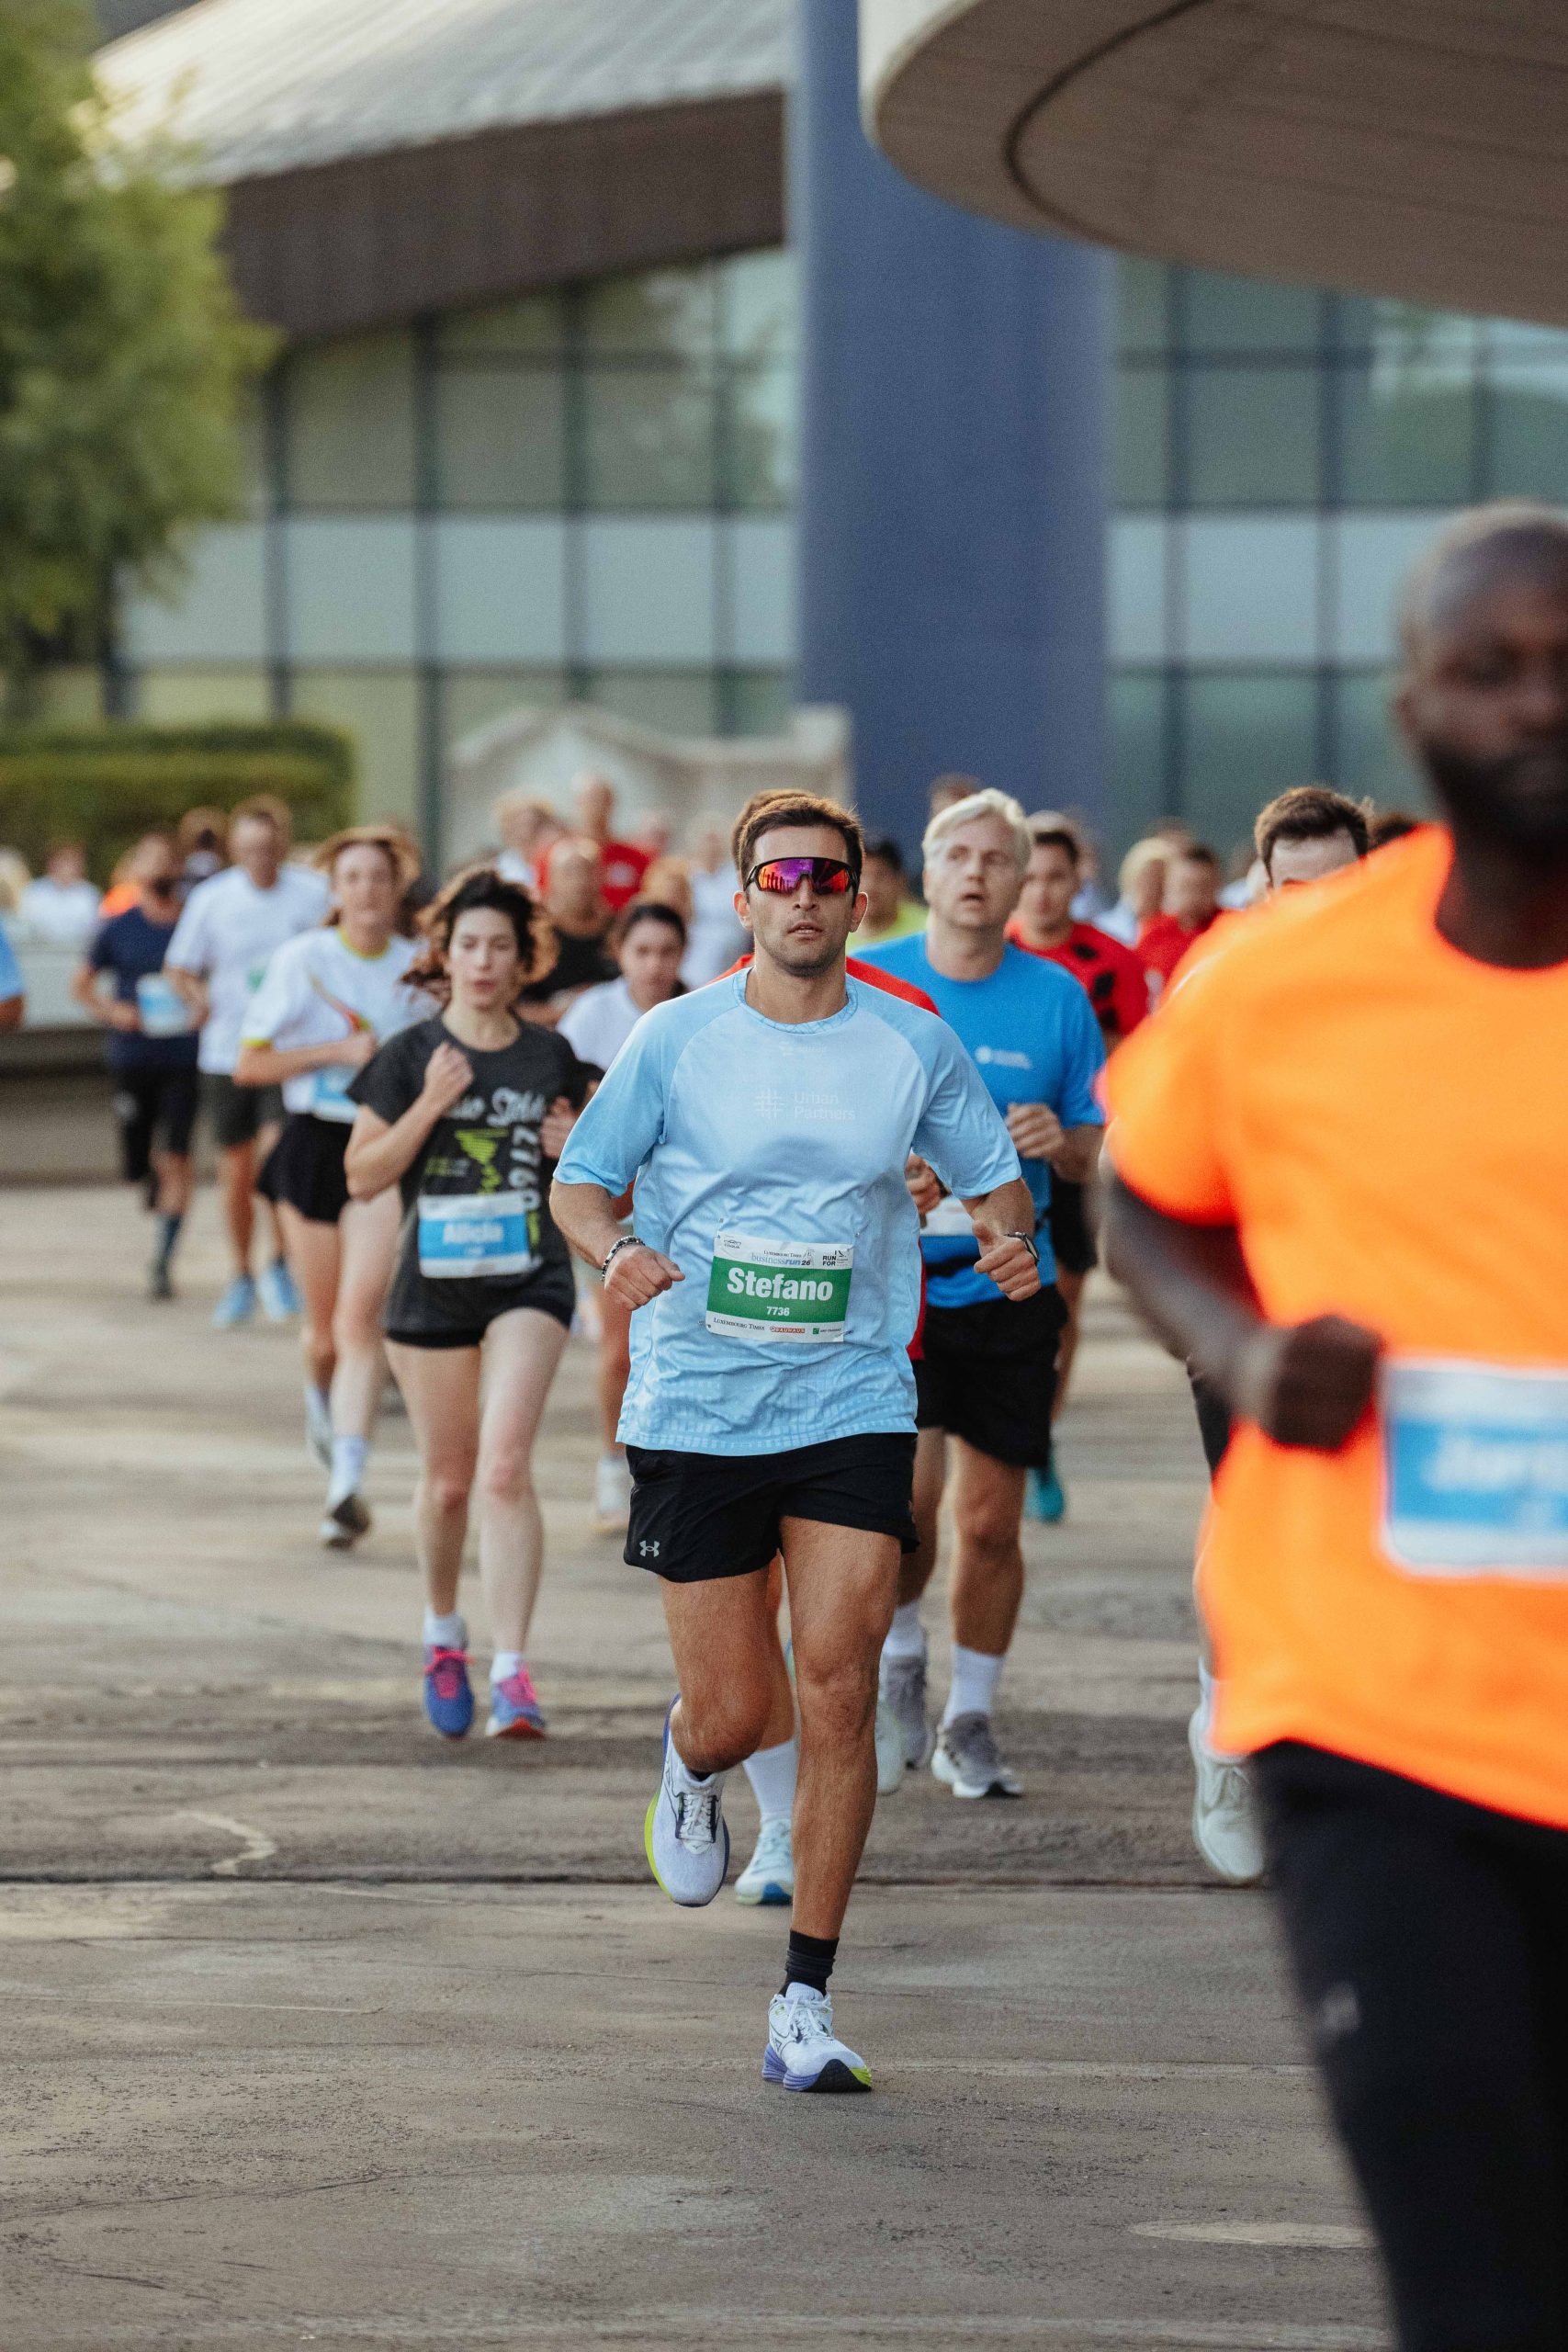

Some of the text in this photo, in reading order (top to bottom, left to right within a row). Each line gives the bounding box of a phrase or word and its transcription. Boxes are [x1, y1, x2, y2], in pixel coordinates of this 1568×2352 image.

[795, 1091, 839, 1104] Urban
[795, 1105, 855, 1119] Partners
[727, 1267, 833, 1301] Stefano
[766, 1306, 790, 1317] 7736
